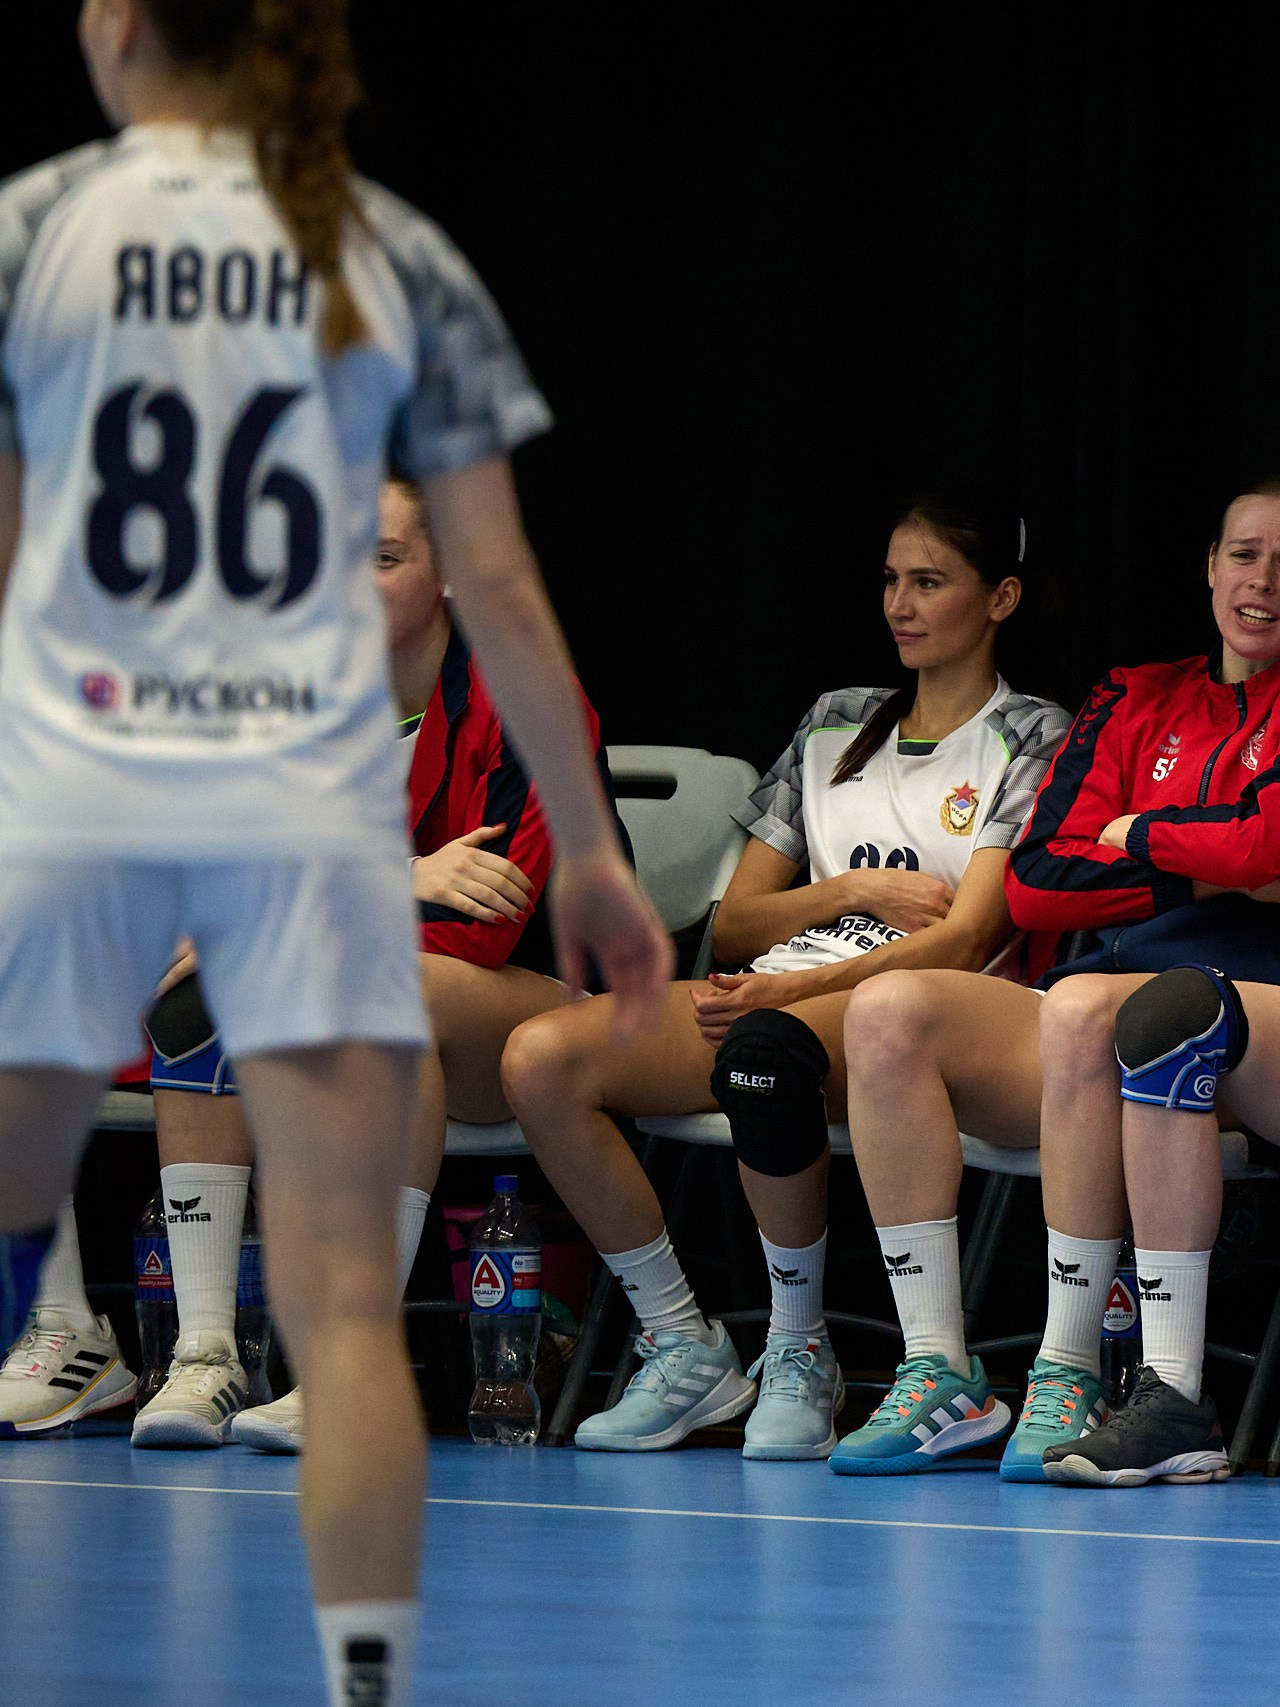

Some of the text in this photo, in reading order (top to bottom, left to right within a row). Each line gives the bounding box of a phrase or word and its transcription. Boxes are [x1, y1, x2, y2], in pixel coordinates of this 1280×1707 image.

[86, 379, 322, 613] 86
[131, 674, 317, 717] РУСКОН
[730, 1071, 776, 1089] SELECT
[167, 1211, 212, 1224] erima
[1051, 1270, 1089, 1288] erima
